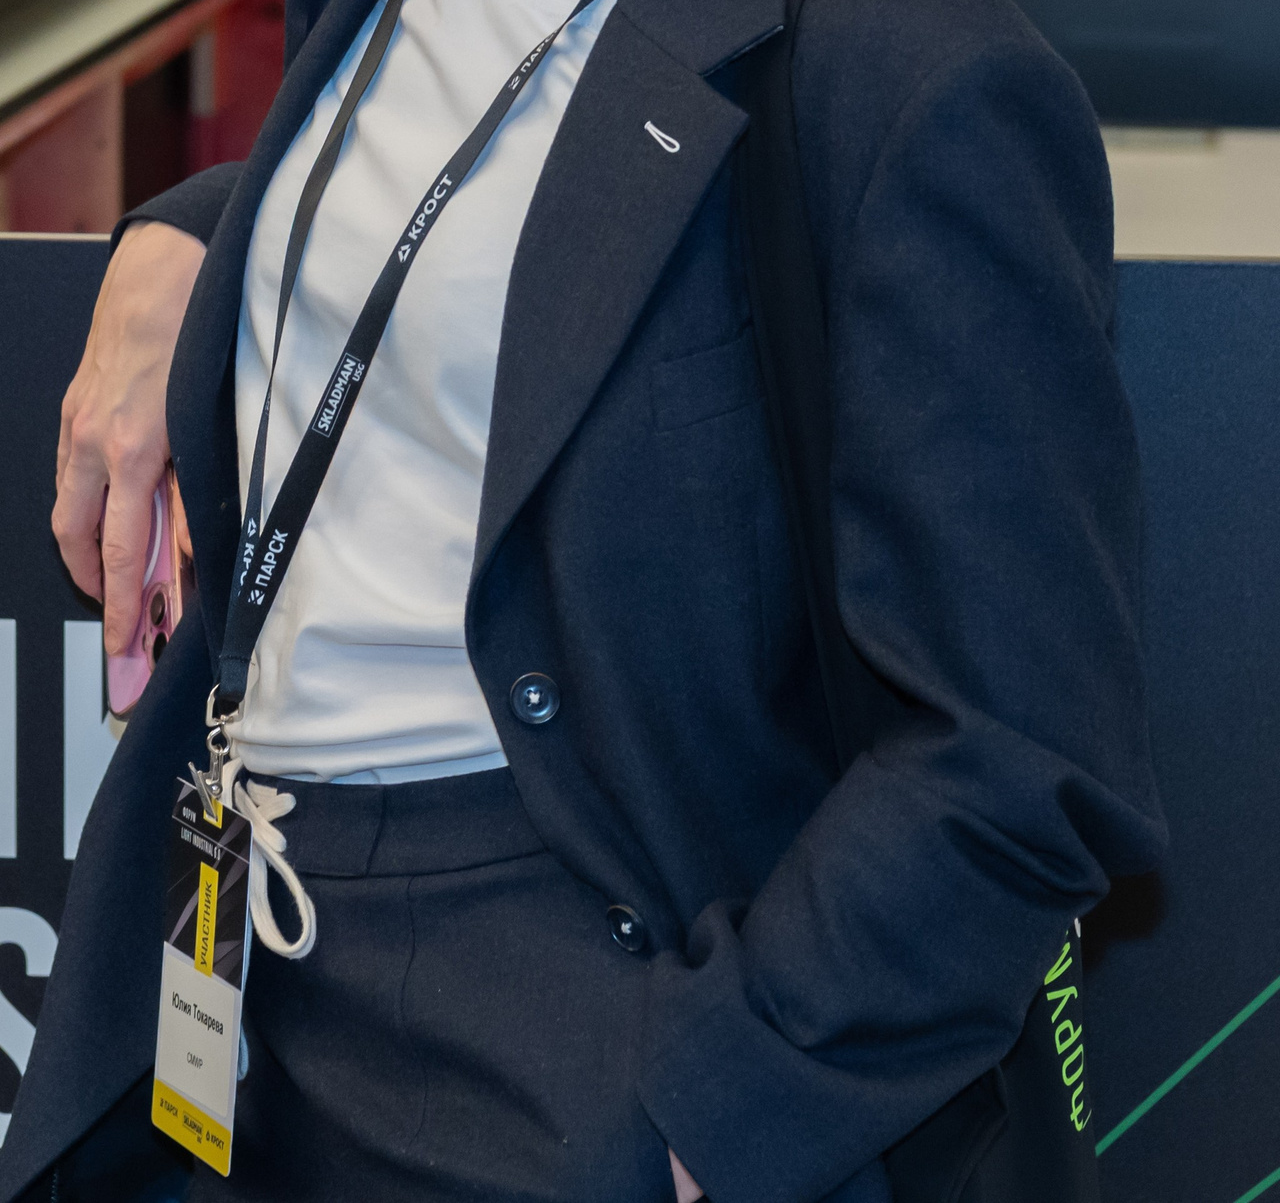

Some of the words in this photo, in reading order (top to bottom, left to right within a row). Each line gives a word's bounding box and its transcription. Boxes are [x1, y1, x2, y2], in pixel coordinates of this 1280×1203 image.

[408, 173, 453, 241] КРОСТ
[318, 358, 356, 432] SKLADMAN
[255, 529, 289, 587] ПАРСК
[200, 880, 213, 968] УЧАСТНИК
[172, 991, 192, 1016] Юлия
[193, 1003, 224, 1036] Токарева
